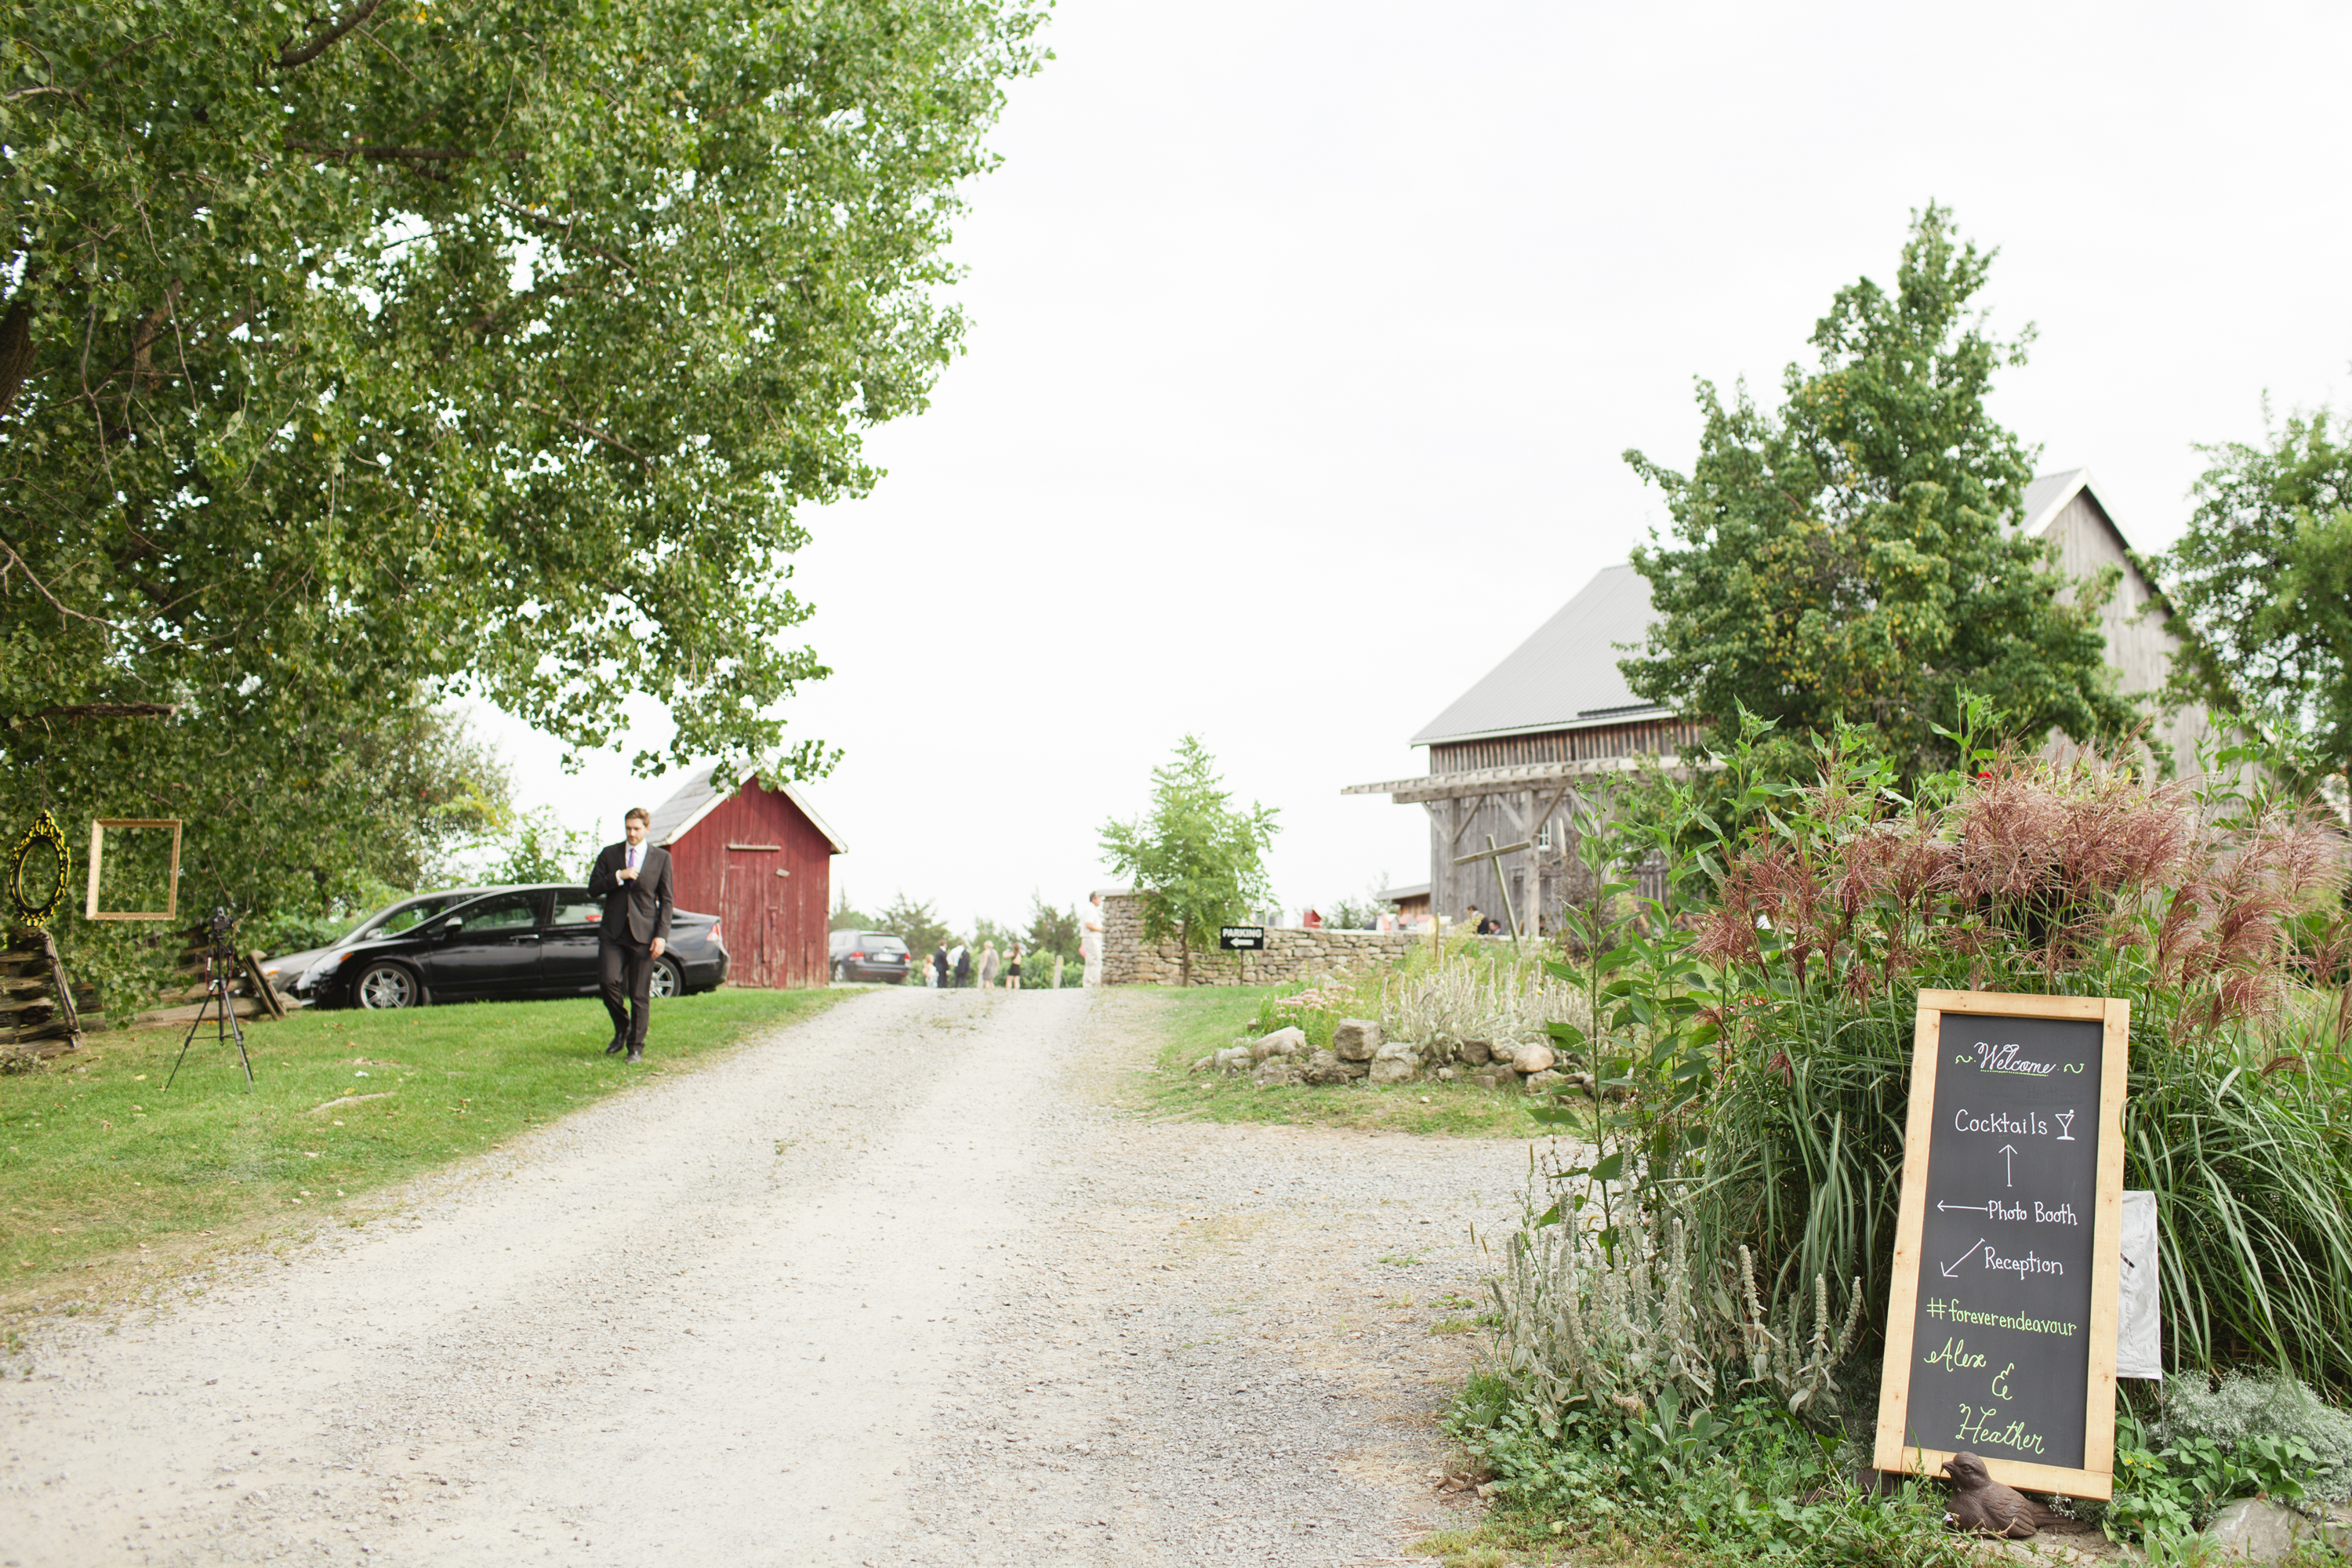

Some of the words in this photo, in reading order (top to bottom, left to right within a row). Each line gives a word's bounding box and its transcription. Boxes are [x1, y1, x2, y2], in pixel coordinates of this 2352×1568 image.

[1222, 928, 1262, 938] PARKING
[1973, 1042, 2056, 1074] Welcome
[1955, 1109, 2048, 1135] Cocktails
[1987, 1200, 2027, 1221] Photo
[2034, 1201, 2078, 1225] Booth
[1984, 1246, 2063, 1280] Reception
[1926, 1297, 2077, 1337] #foreverendeavour
[1924, 1337, 1987, 1372] Alex
[1991, 1363, 2014, 1400] &
[1955, 1403, 2045, 1454] Heather
